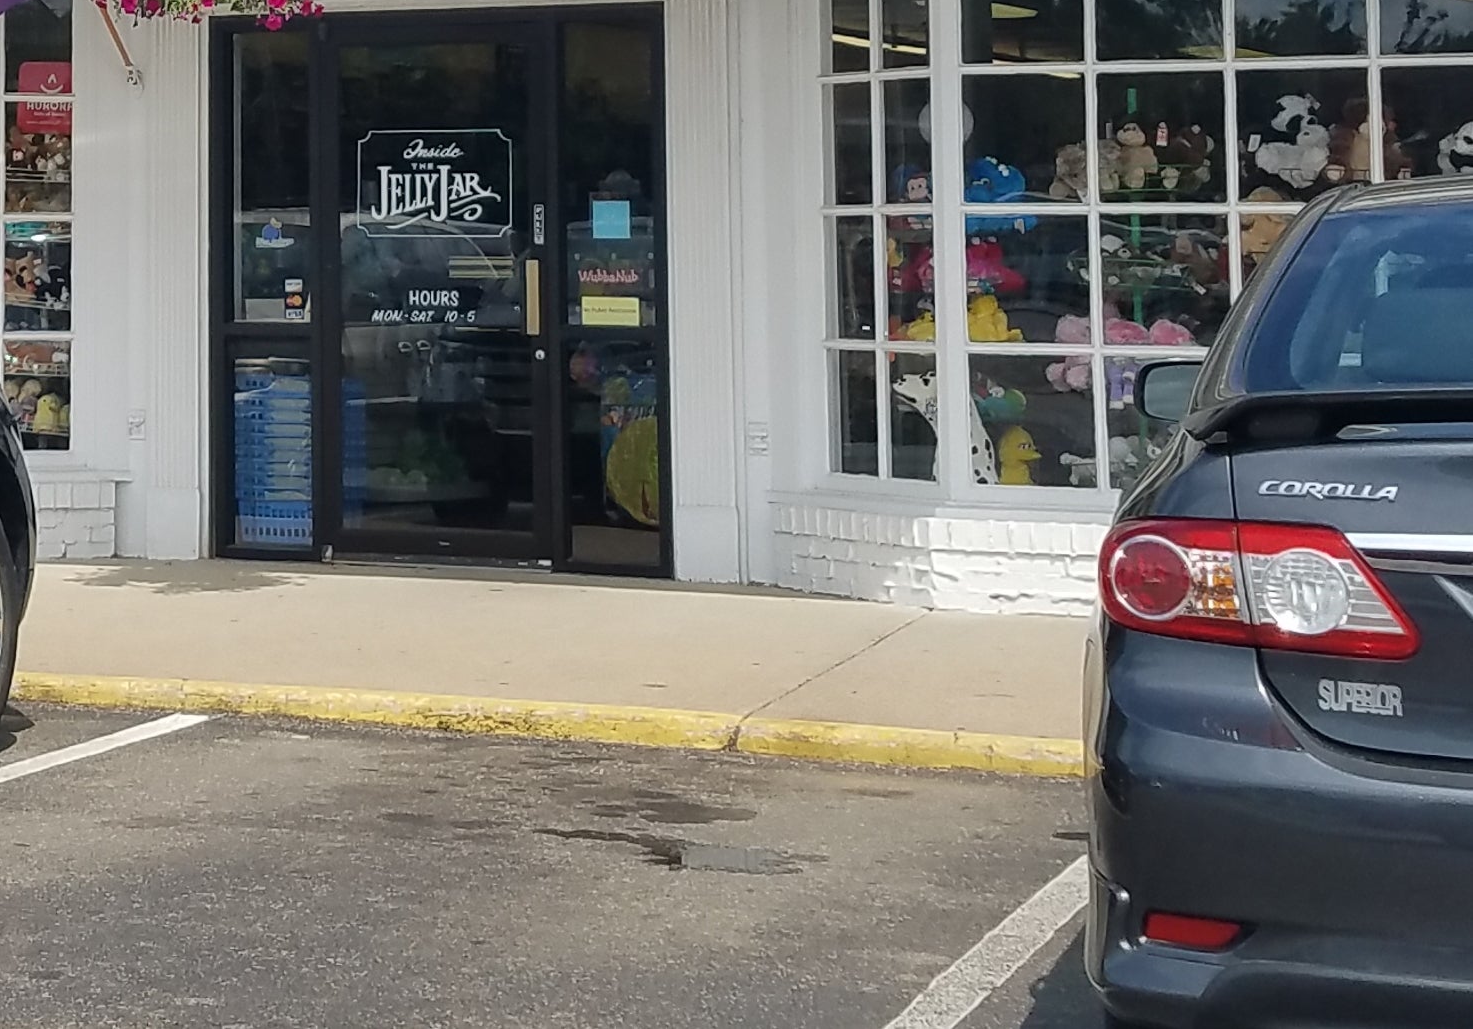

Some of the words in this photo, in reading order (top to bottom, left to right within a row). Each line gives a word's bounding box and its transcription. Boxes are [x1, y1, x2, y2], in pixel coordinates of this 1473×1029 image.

[403, 139, 464, 159] Inside
[411, 162, 433, 170] THE
[371, 165, 440, 219] JELLY
[409, 289, 460, 307] HOURS
[1258, 480, 1398, 501] COROLLA
